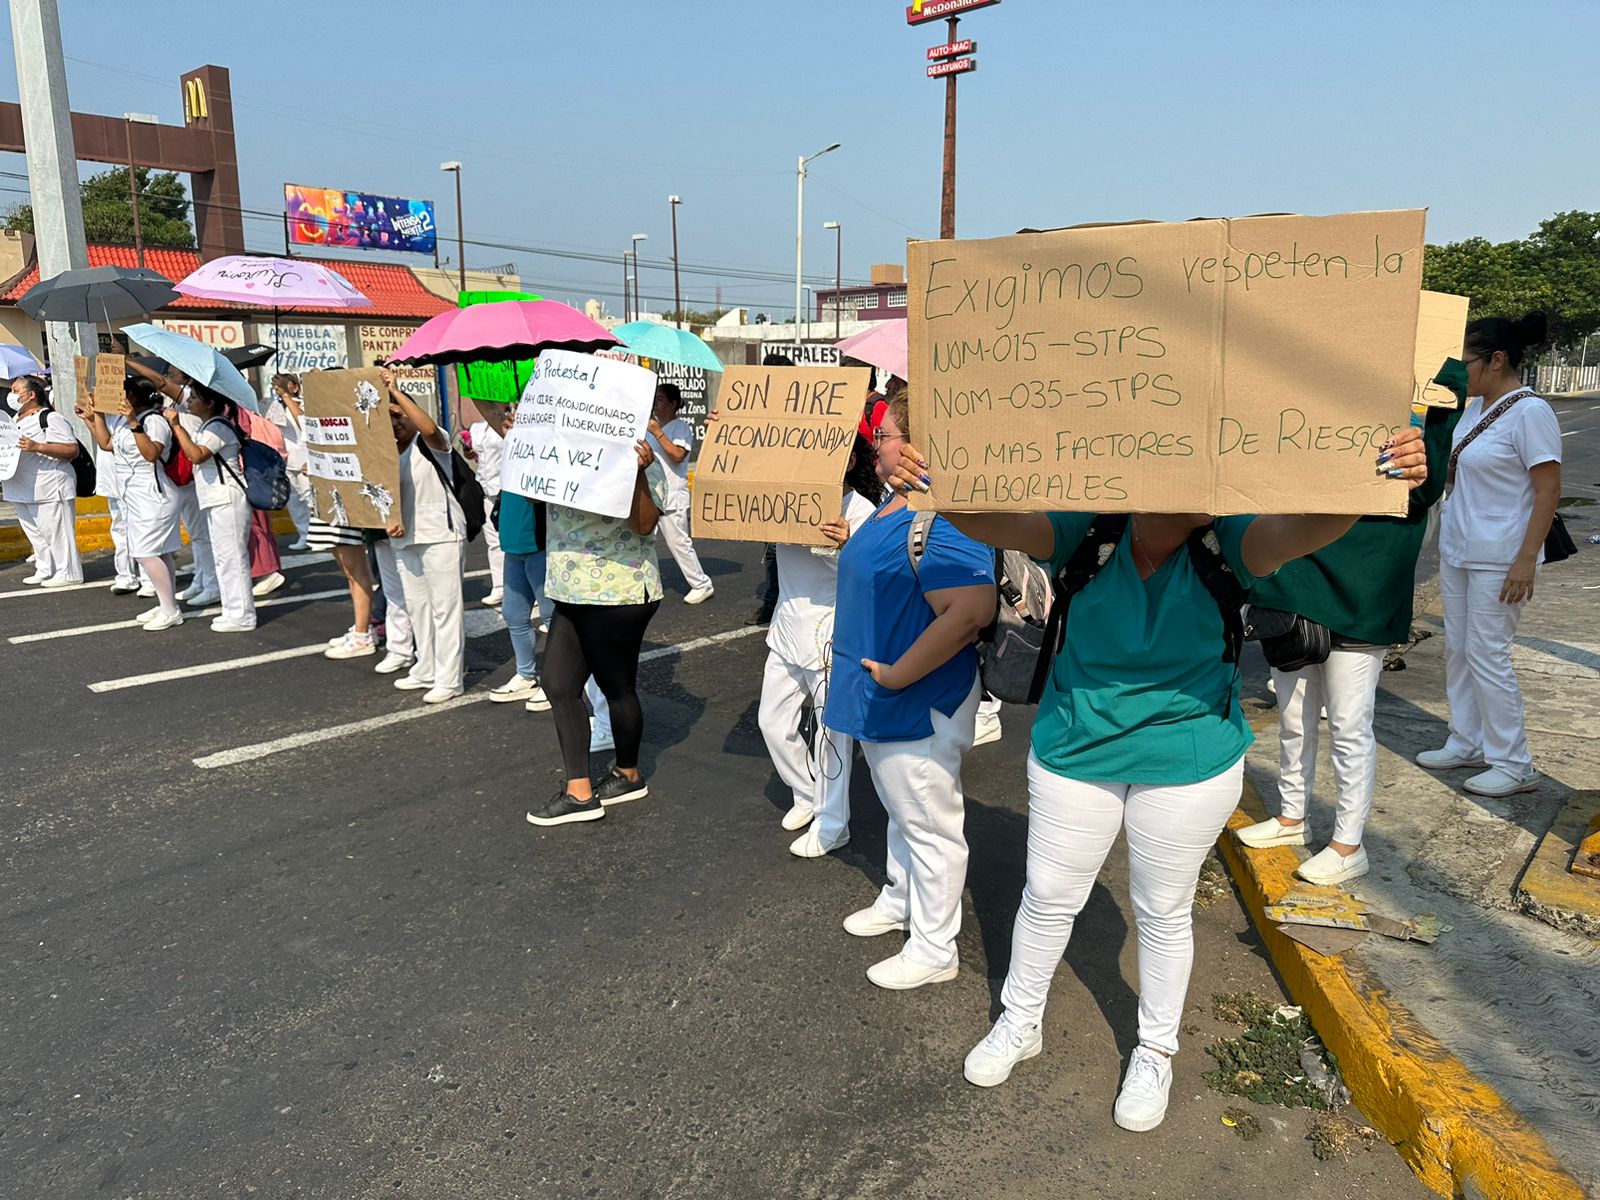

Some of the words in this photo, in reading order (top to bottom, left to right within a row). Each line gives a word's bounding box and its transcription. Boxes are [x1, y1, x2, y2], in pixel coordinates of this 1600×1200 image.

[923, 0, 980, 16] McDonal
[927, 60, 968, 75] DESAYUNOS
[1374, 234, 1403, 278] la
[269, 328, 331, 339] AMUEBLA
[361, 326, 376, 337] SE
[272, 340, 290, 351] TU
[295, 341, 337, 351] HOGAR
[362, 340, 402, 351] PANTA
[764, 345, 838, 363] VITRALES
[392, 368, 435, 378] MPUESTAS
[680, 391, 702, 399] ERSONA
[726, 374, 771, 411] SIN
[784, 380, 848, 415] AIRE
[555, 396, 636, 424] ACONDICIONADO
[516, 412, 556, 425] ELEVADORES
[562, 413, 637, 438] INSERVIBLES
[334, 432, 349, 441] LOS
[714, 422, 855, 457] ACONDICIONADO
[540, 446, 559, 464] LA
[984, 441, 1043, 466] MAS
[1056, 430, 1193, 461] FACTORES
[711, 450, 739, 474] NI
[520, 473, 556, 497] UMAE
[951, 473, 1128, 503] LABORALES
[702, 491, 823, 527] ELEVADORES
